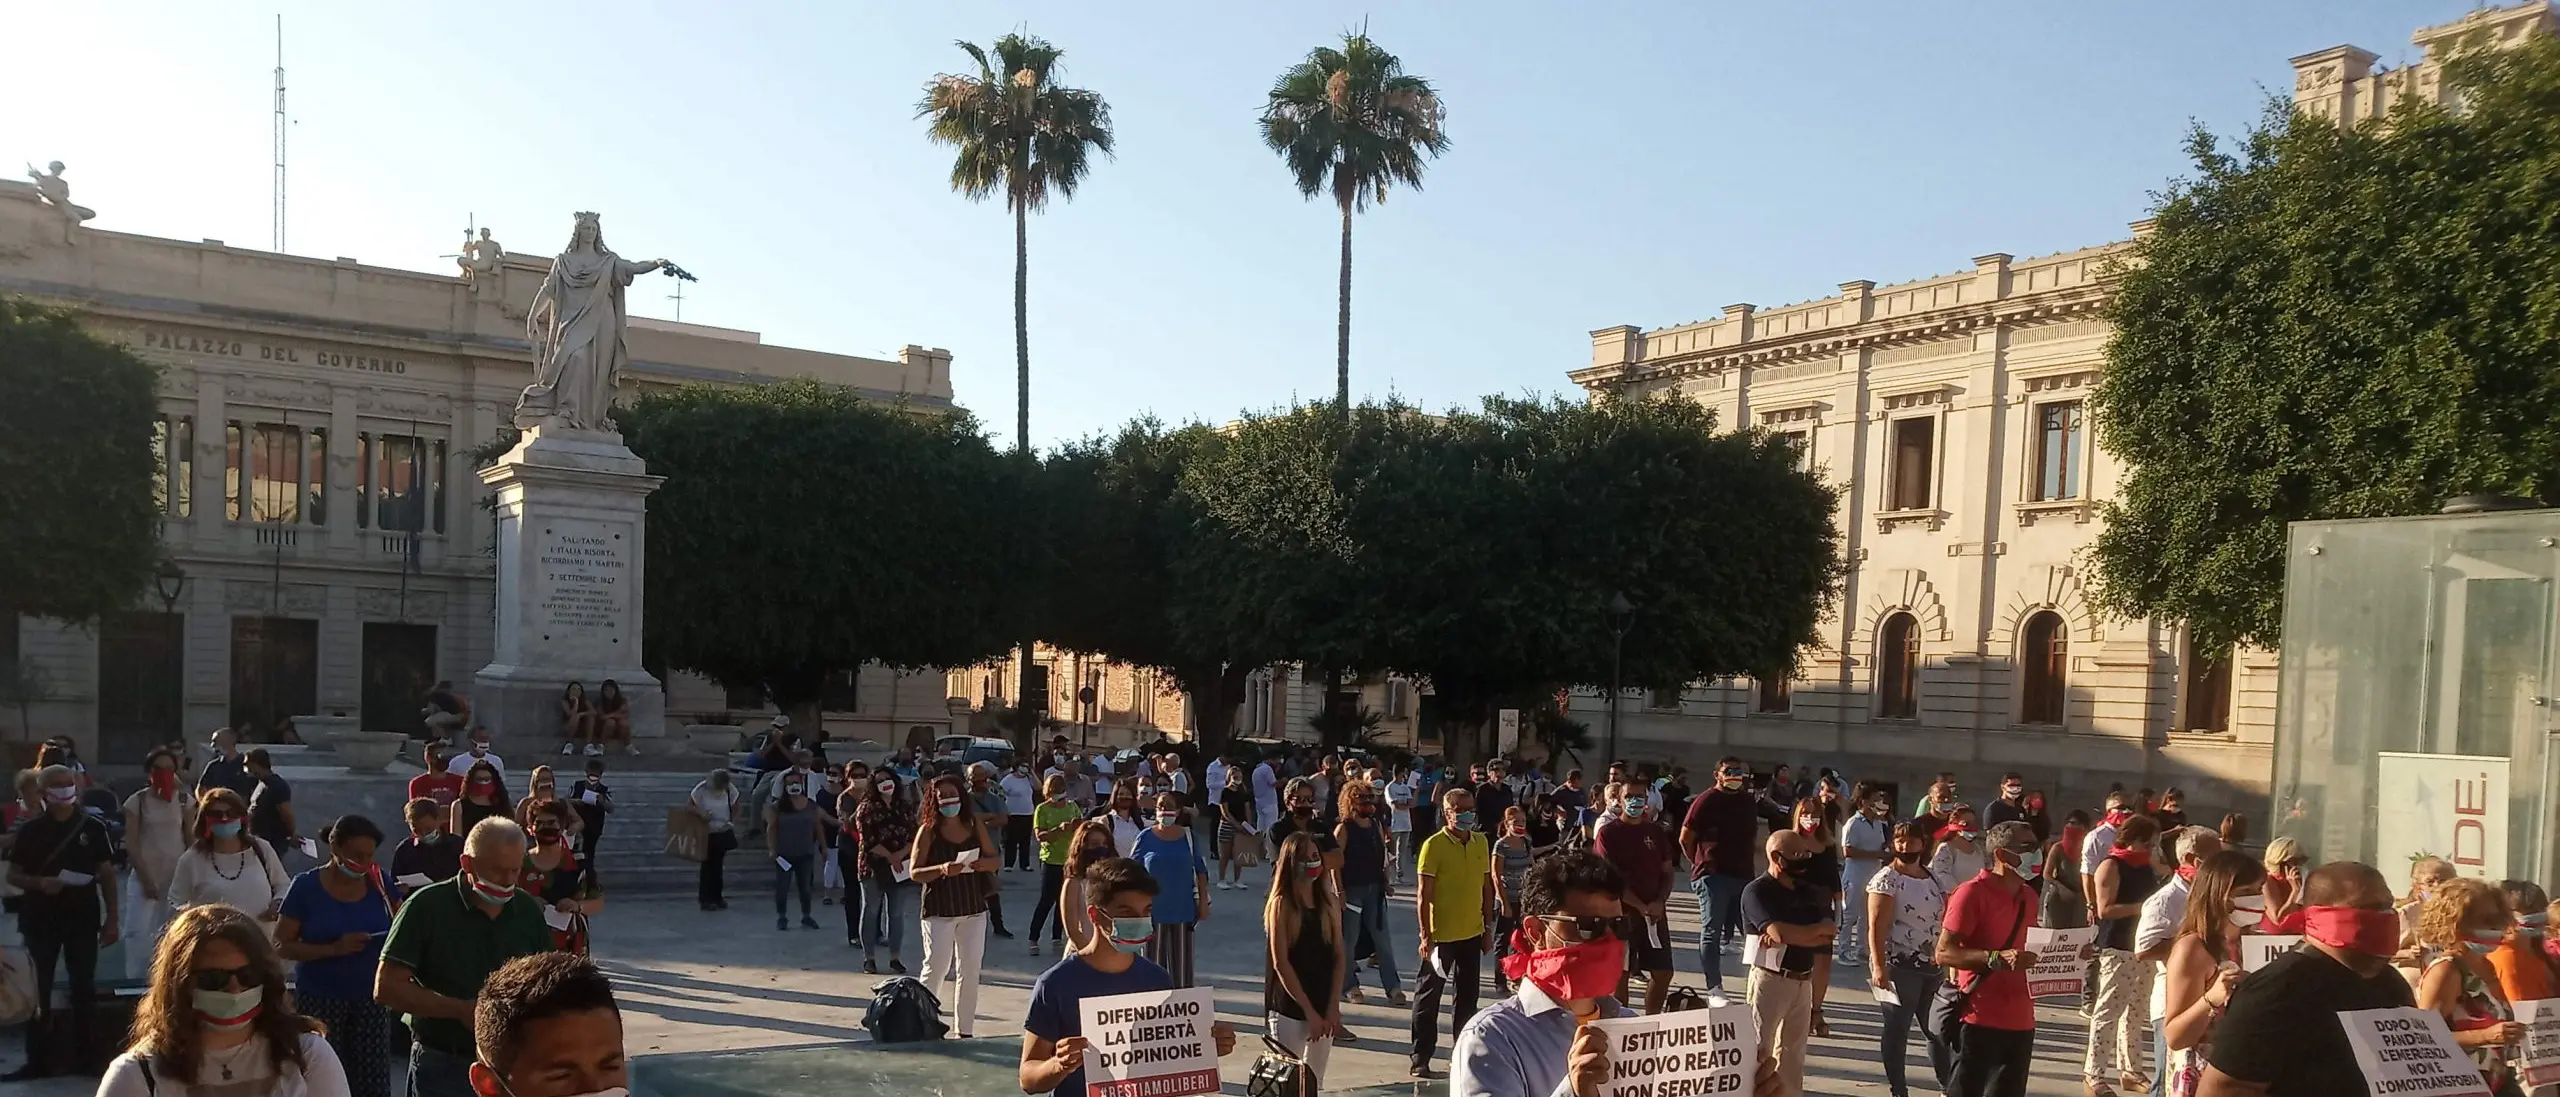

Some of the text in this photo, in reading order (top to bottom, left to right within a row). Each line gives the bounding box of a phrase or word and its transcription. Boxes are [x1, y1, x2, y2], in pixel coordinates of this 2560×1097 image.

[143, 332, 407, 375] PALAZZO DEL GOVERNO
[1097, 1001, 1200, 1026] DIFENDIAMO
[2374, 1019, 2410, 1032] DOPO
[1105, 1019, 1196, 1046] LA LIBERTÀ
[1621, 1022, 1736, 1052] ISTITUIRE UN
[2382, 1032, 2437, 1047] PANDEMIA
[1100, 1043, 1202, 1068] DI OPINIONE
[1613, 1047, 1742, 1080] NUOVO REATO
[2379, 1047, 2452, 1062] L'EMERGENZA
[2406, 1062, 2436, 1076] NON
[1613, 1073, 1741, 1097] NON SERVE ED
[2375, 1074, 2482, 1094] L'OMOTRANSFOBIA
